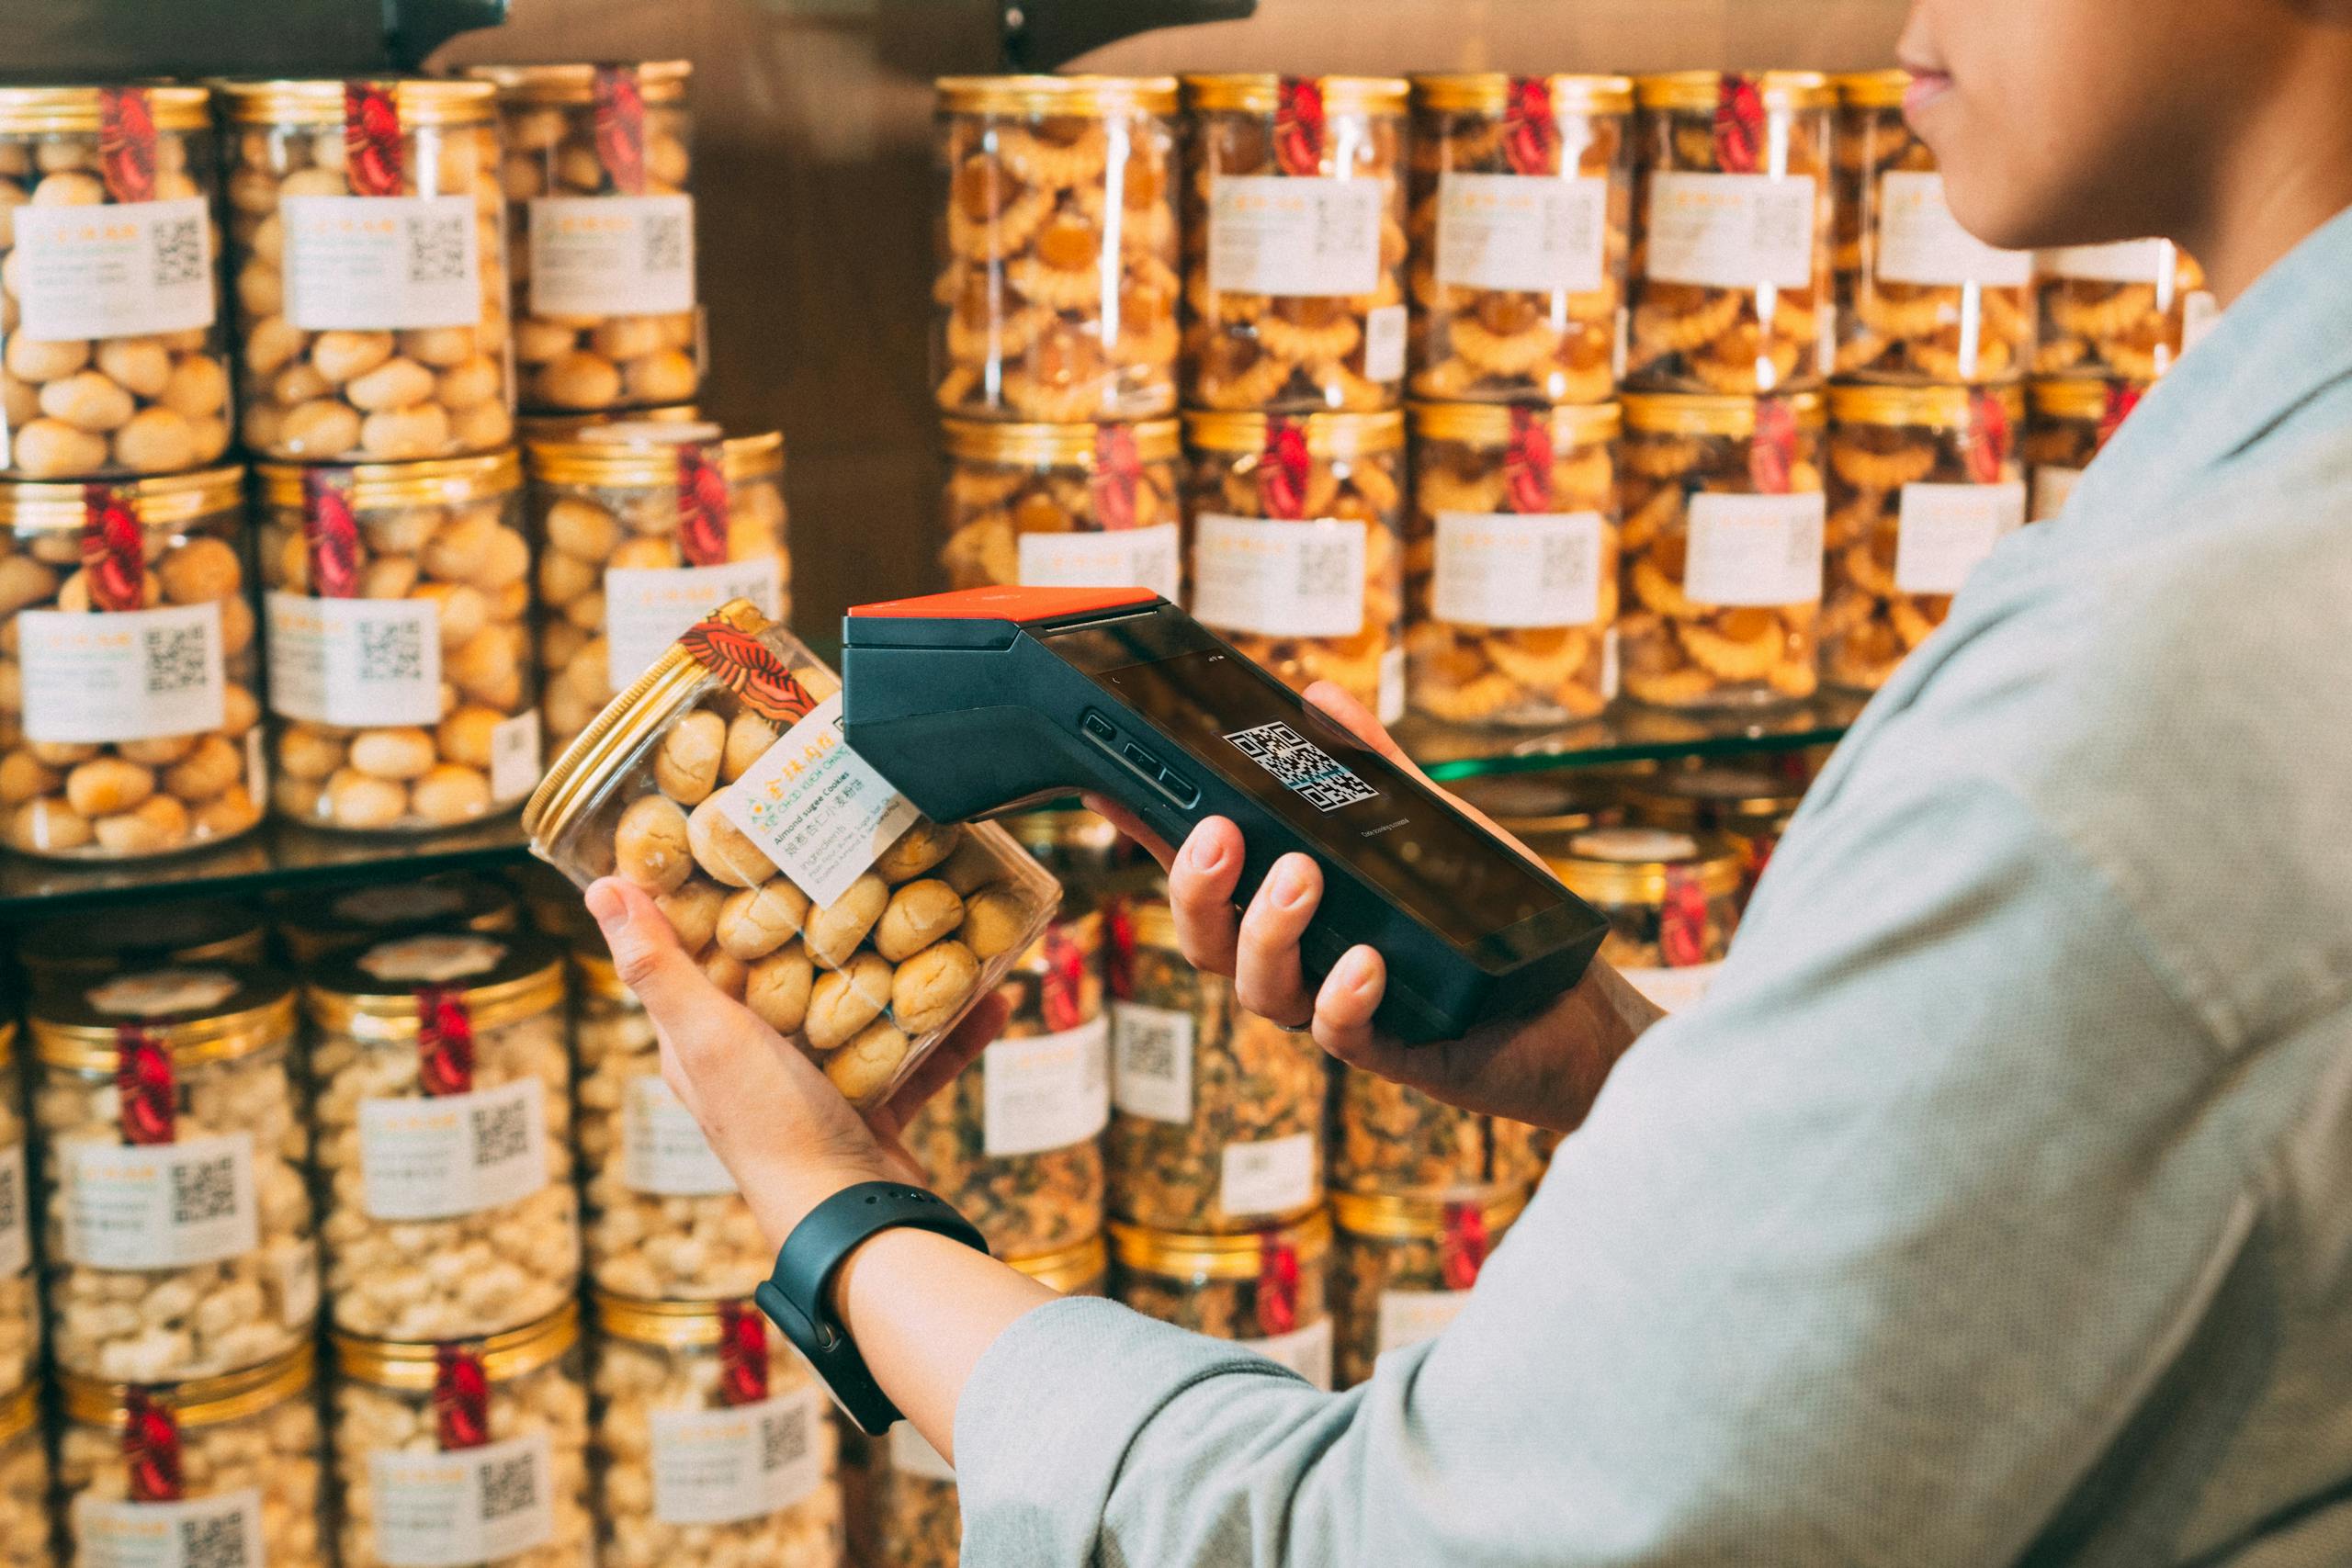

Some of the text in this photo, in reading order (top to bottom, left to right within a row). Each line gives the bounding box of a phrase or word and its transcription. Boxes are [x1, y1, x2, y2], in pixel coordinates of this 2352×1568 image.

[773, 770, 849, 845] Almond sugee Cookies
